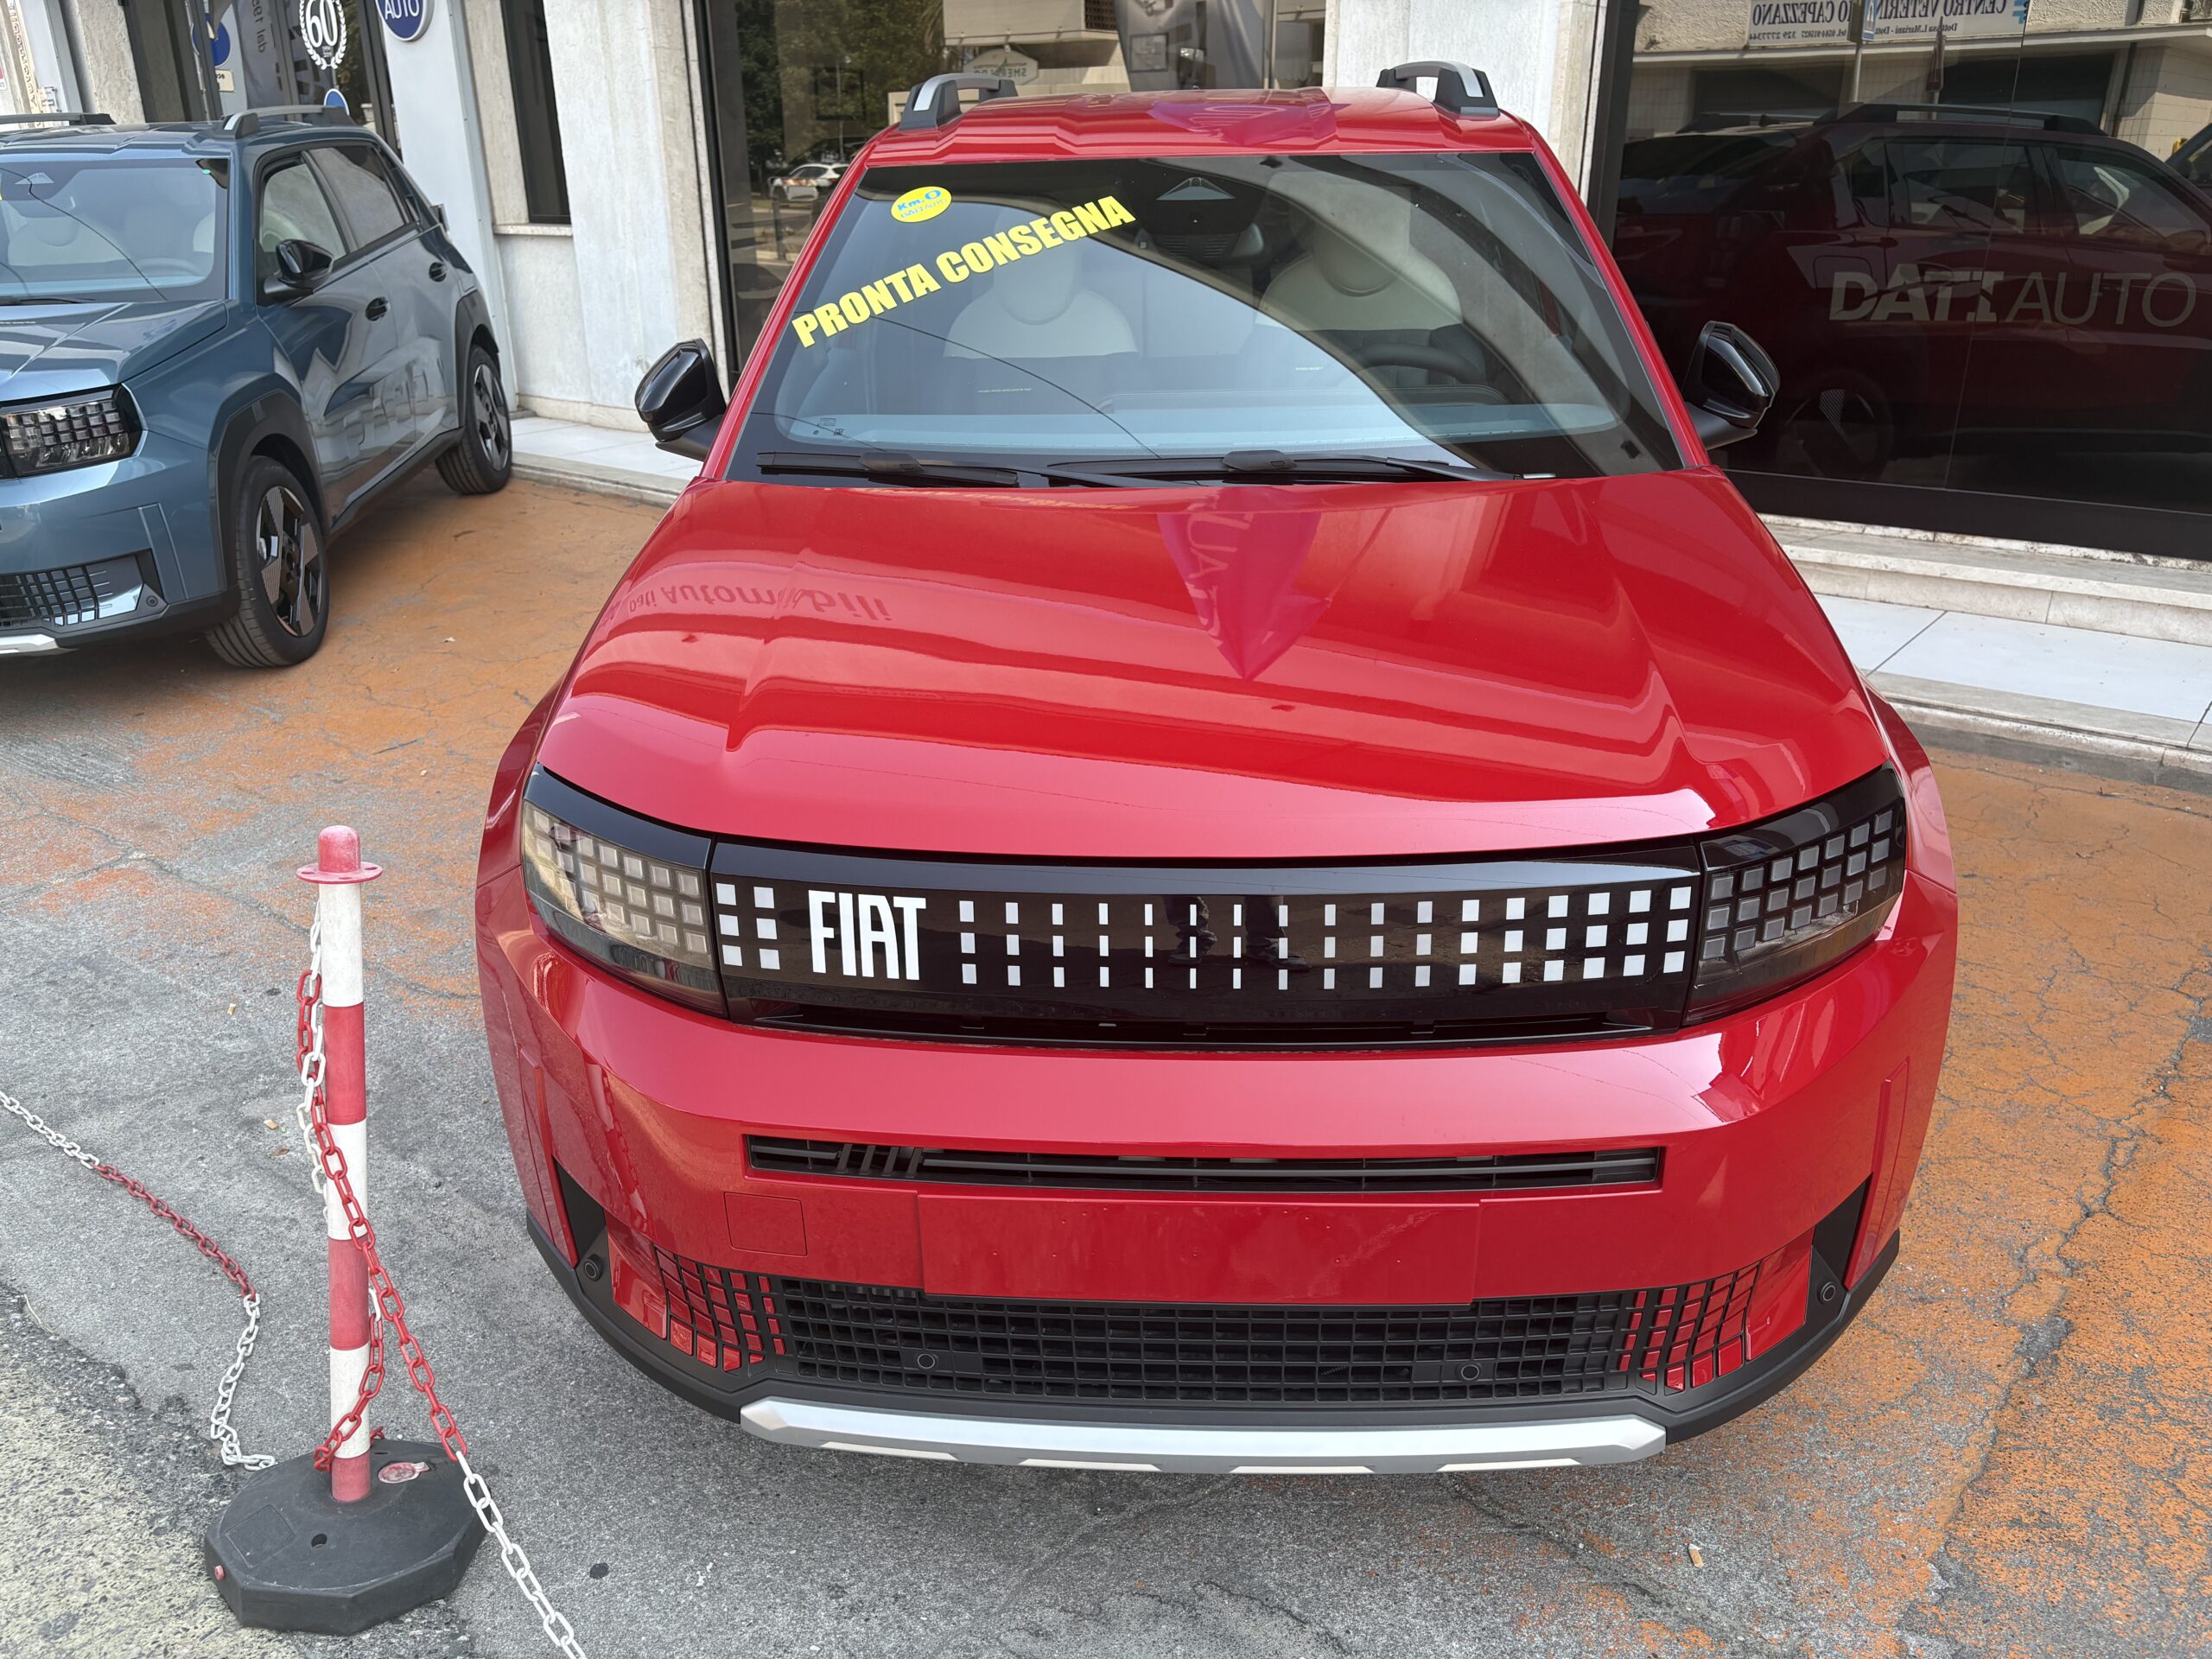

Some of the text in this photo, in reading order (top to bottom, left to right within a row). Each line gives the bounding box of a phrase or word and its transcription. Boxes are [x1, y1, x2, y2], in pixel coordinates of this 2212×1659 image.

[306, 0, 338, 48] 60
[791, 195, 1136, 347] PRONTA CONSEGNA
[808, 890, 927, 981] FIAT
